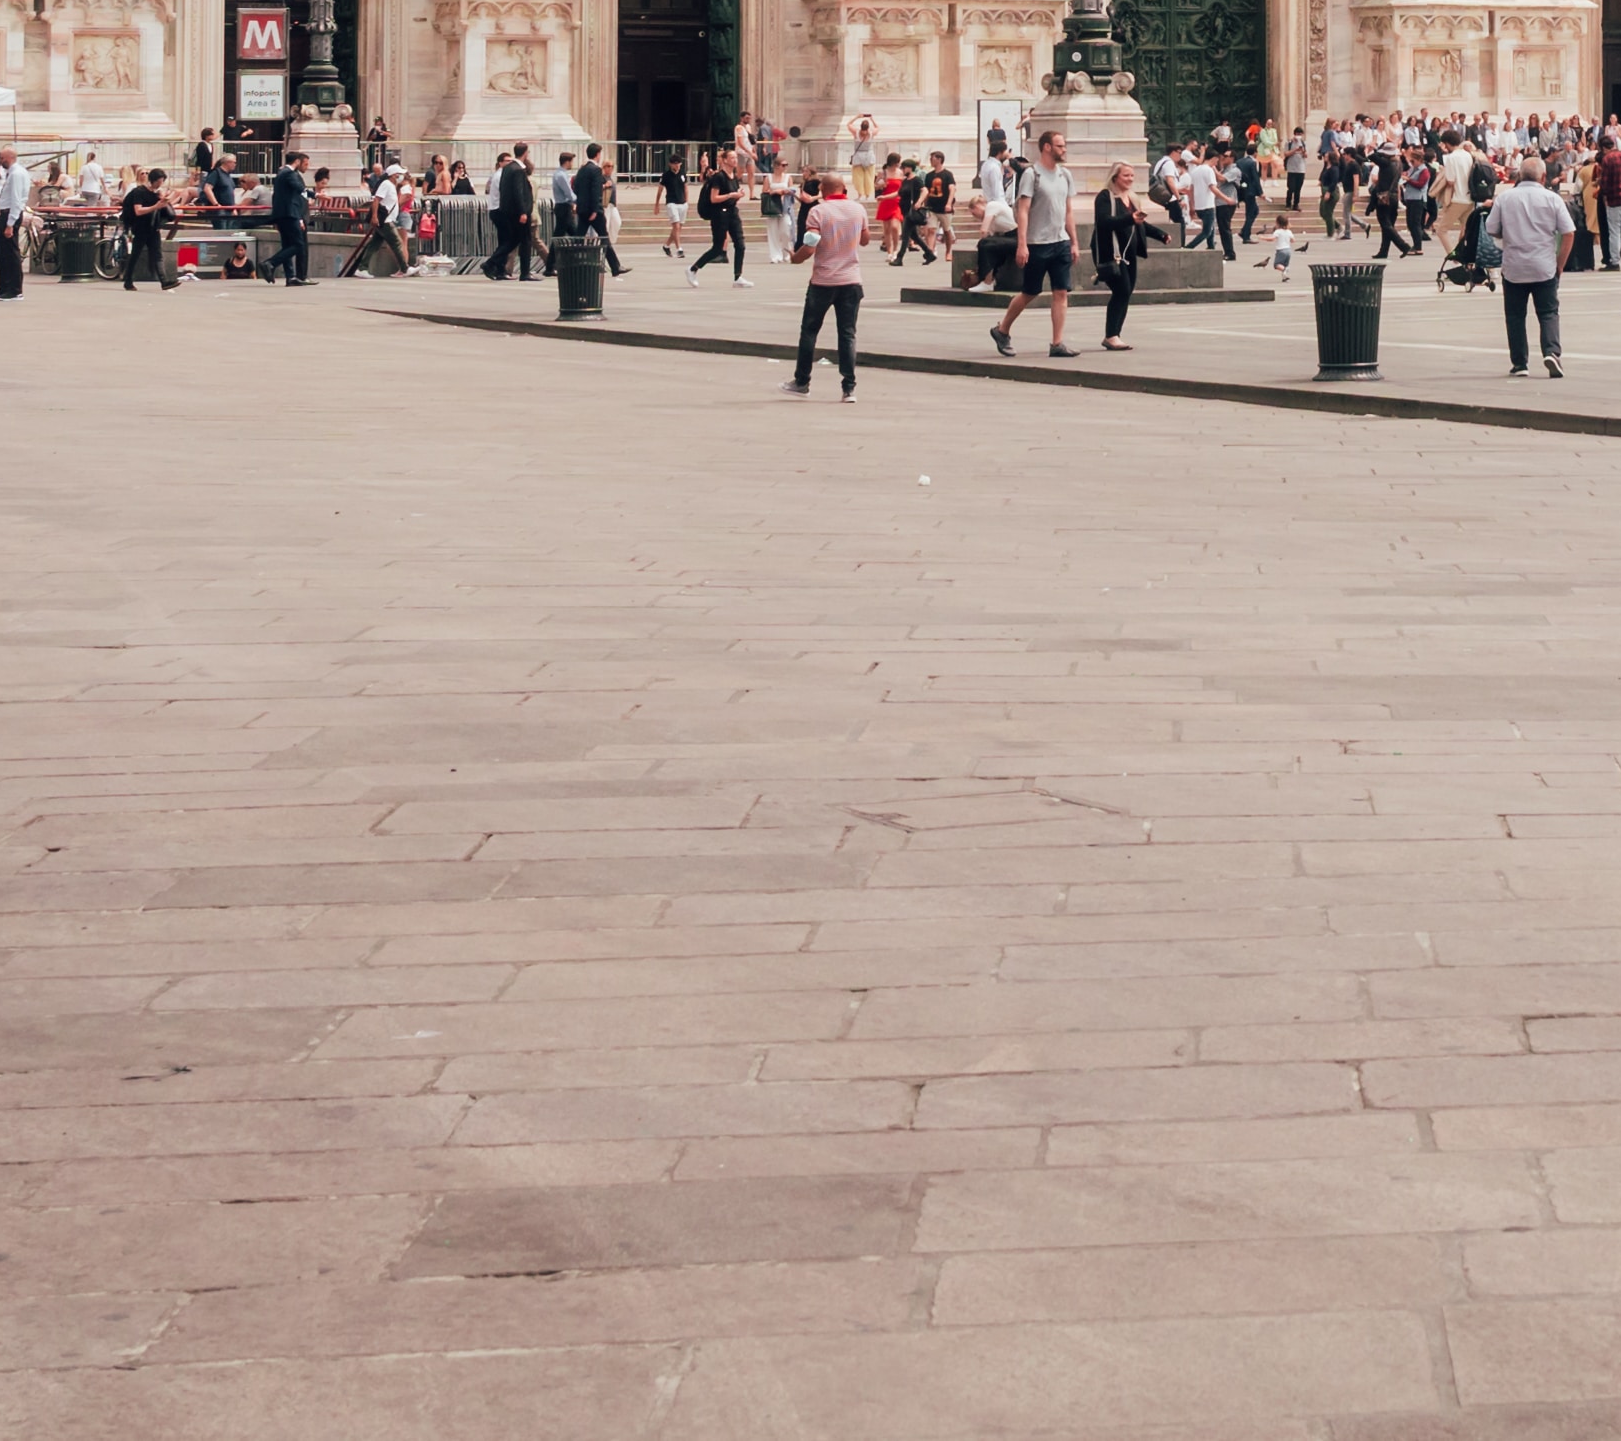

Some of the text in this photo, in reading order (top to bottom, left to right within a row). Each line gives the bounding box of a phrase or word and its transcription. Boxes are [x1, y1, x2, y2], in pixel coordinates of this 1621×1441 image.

[243, 20, 281, 49] M
[244, 88, 281, 98] infopoint
[247, 99, 268, 108] Area
